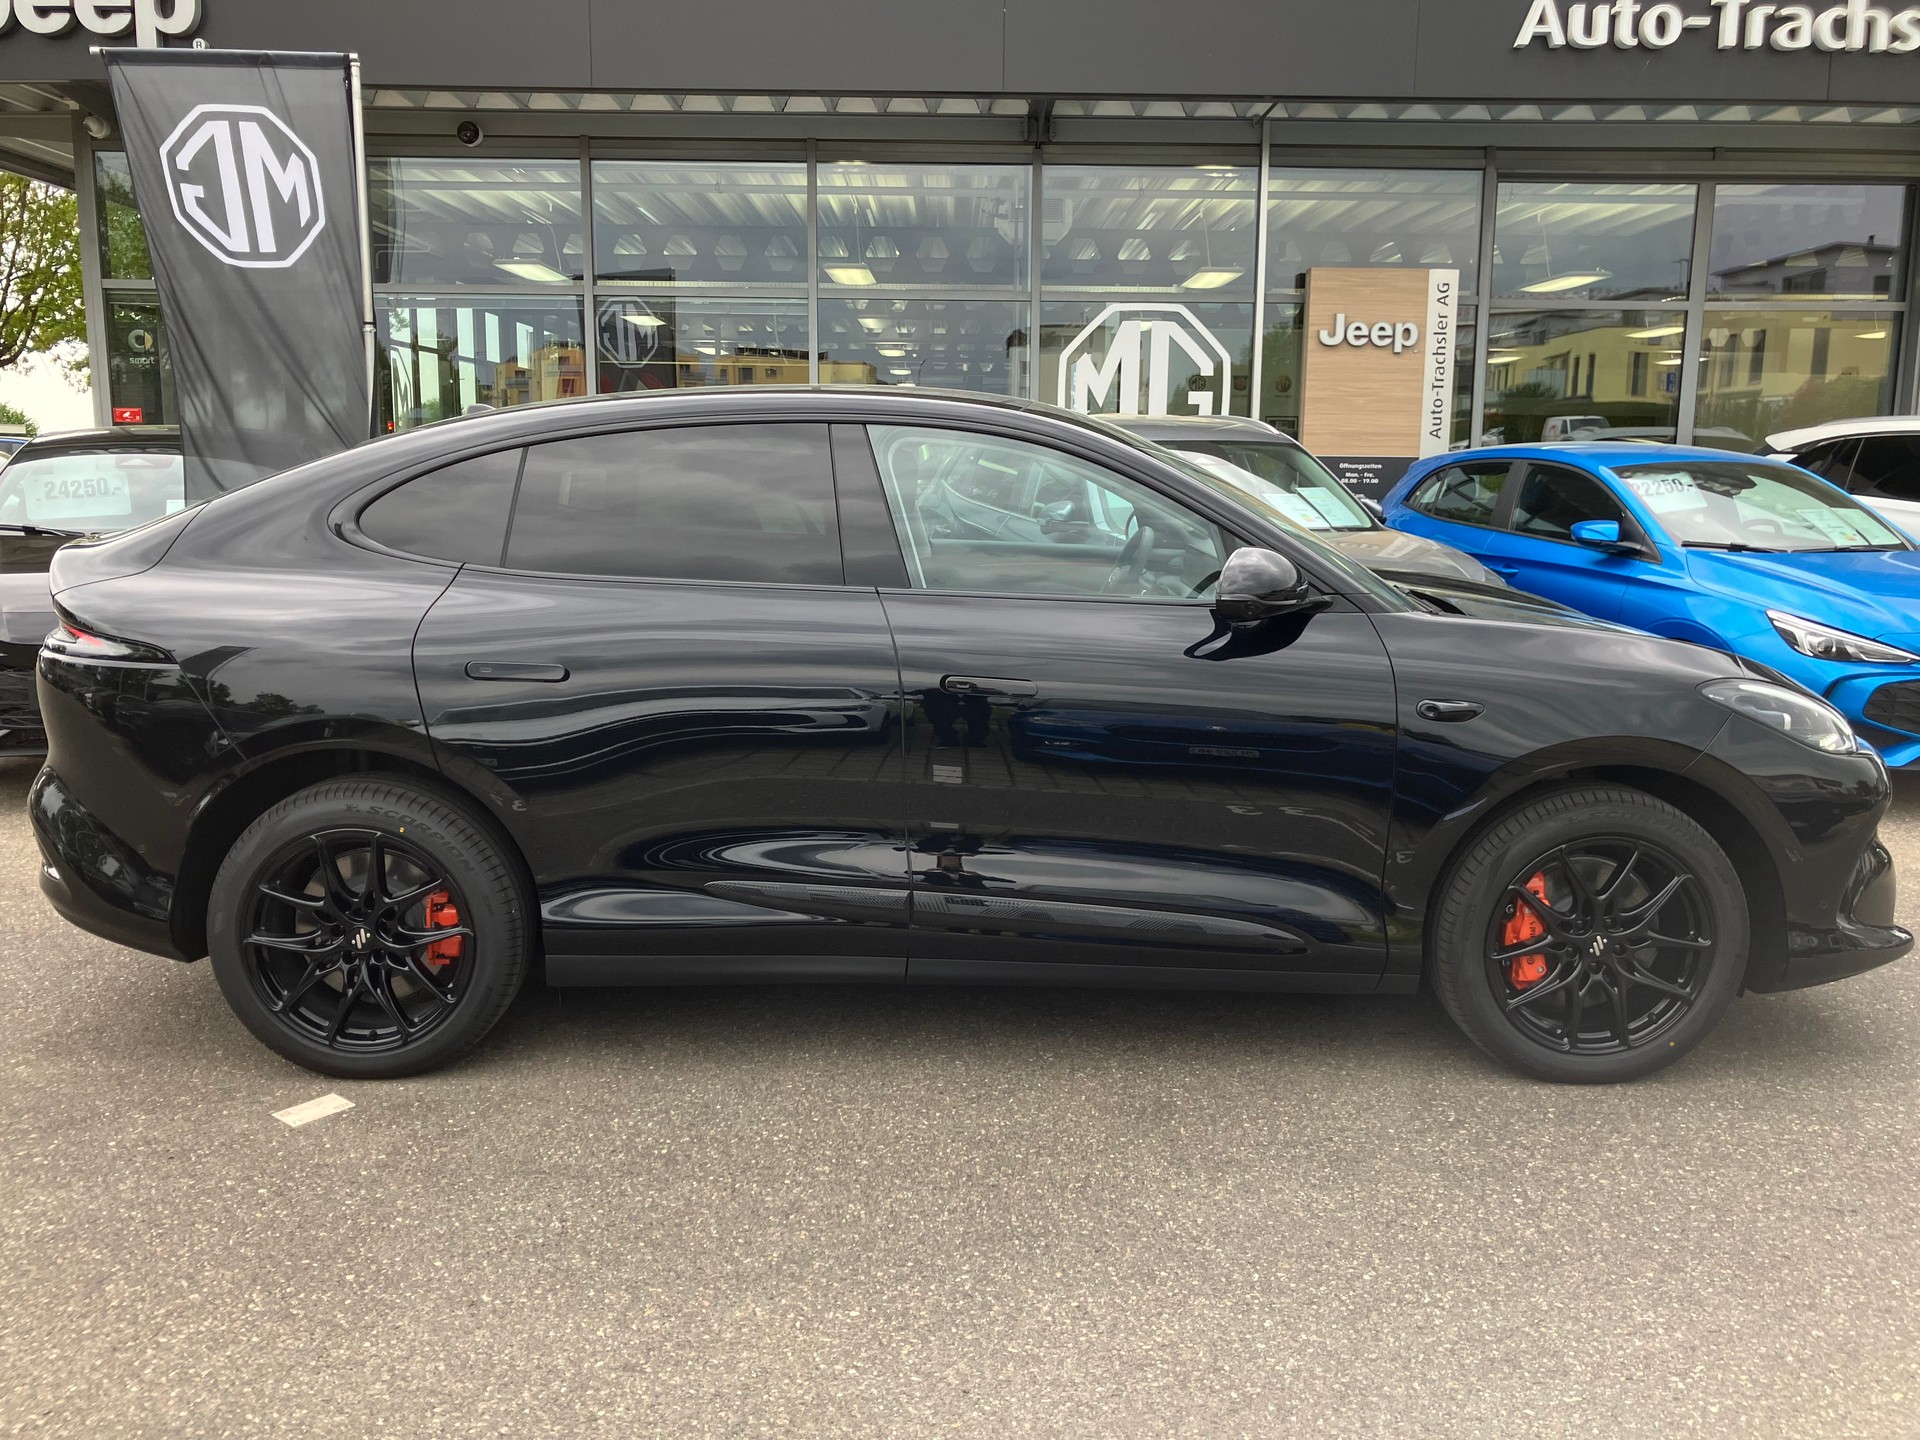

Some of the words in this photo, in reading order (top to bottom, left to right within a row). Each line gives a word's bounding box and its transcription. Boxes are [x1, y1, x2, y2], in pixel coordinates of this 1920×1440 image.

[0, 0, 199, 48] eep
[1436, 282, 1450, 307] AG
[1318, 313, 1419, 354] Jeep
[129, 356, 155, 365] smart
[1073, 320, 1215, 416] MG
[1429, 312, 1450, 440] Auto-Trachsler
[44, 477, 121, 500] 24250.-
